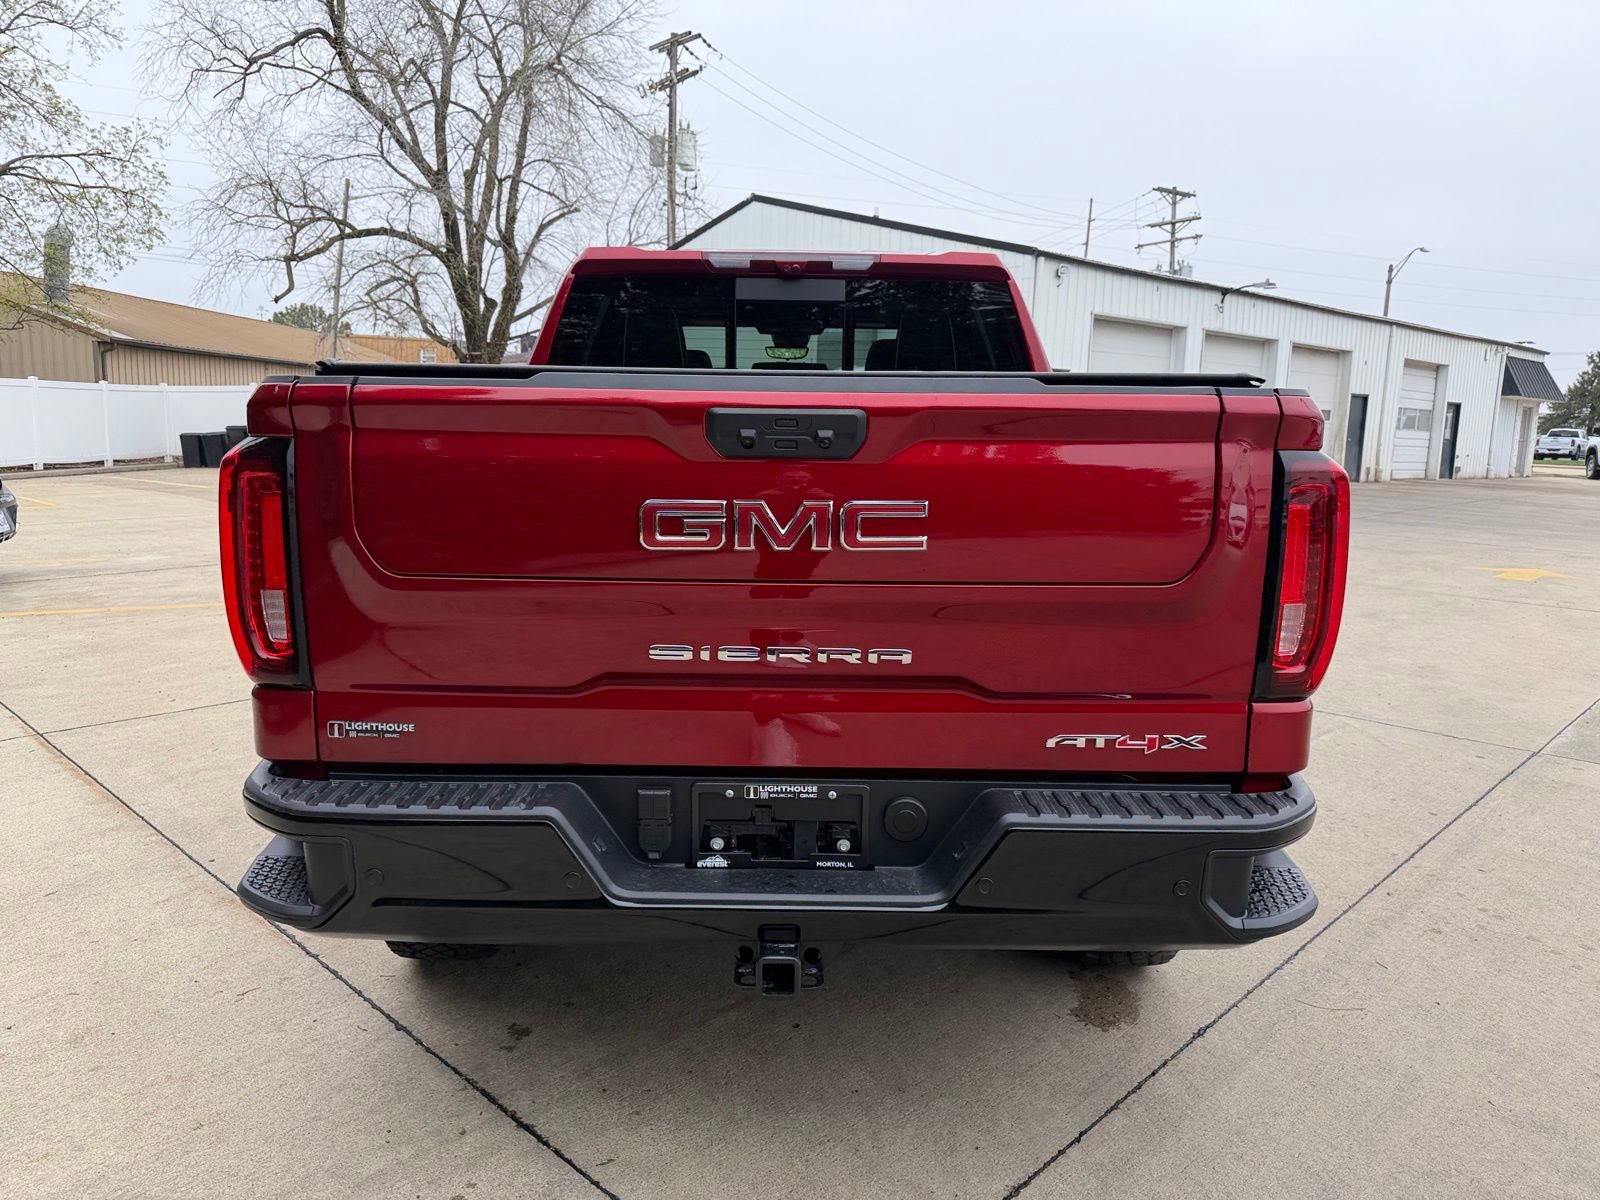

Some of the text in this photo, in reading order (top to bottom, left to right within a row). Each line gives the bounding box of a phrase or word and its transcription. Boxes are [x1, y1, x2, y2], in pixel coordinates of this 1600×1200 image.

[639, 499, 929, 551] GMC
[648, 644, 913, 665] SIERRA
[345, 721, 415, 732] LIGHTHOUSE
[1045, 734, 1208, 754] AT4X
[760, 785, 818, 793] LIGHTHOUSE
[696, 859, 729, 868] everest
